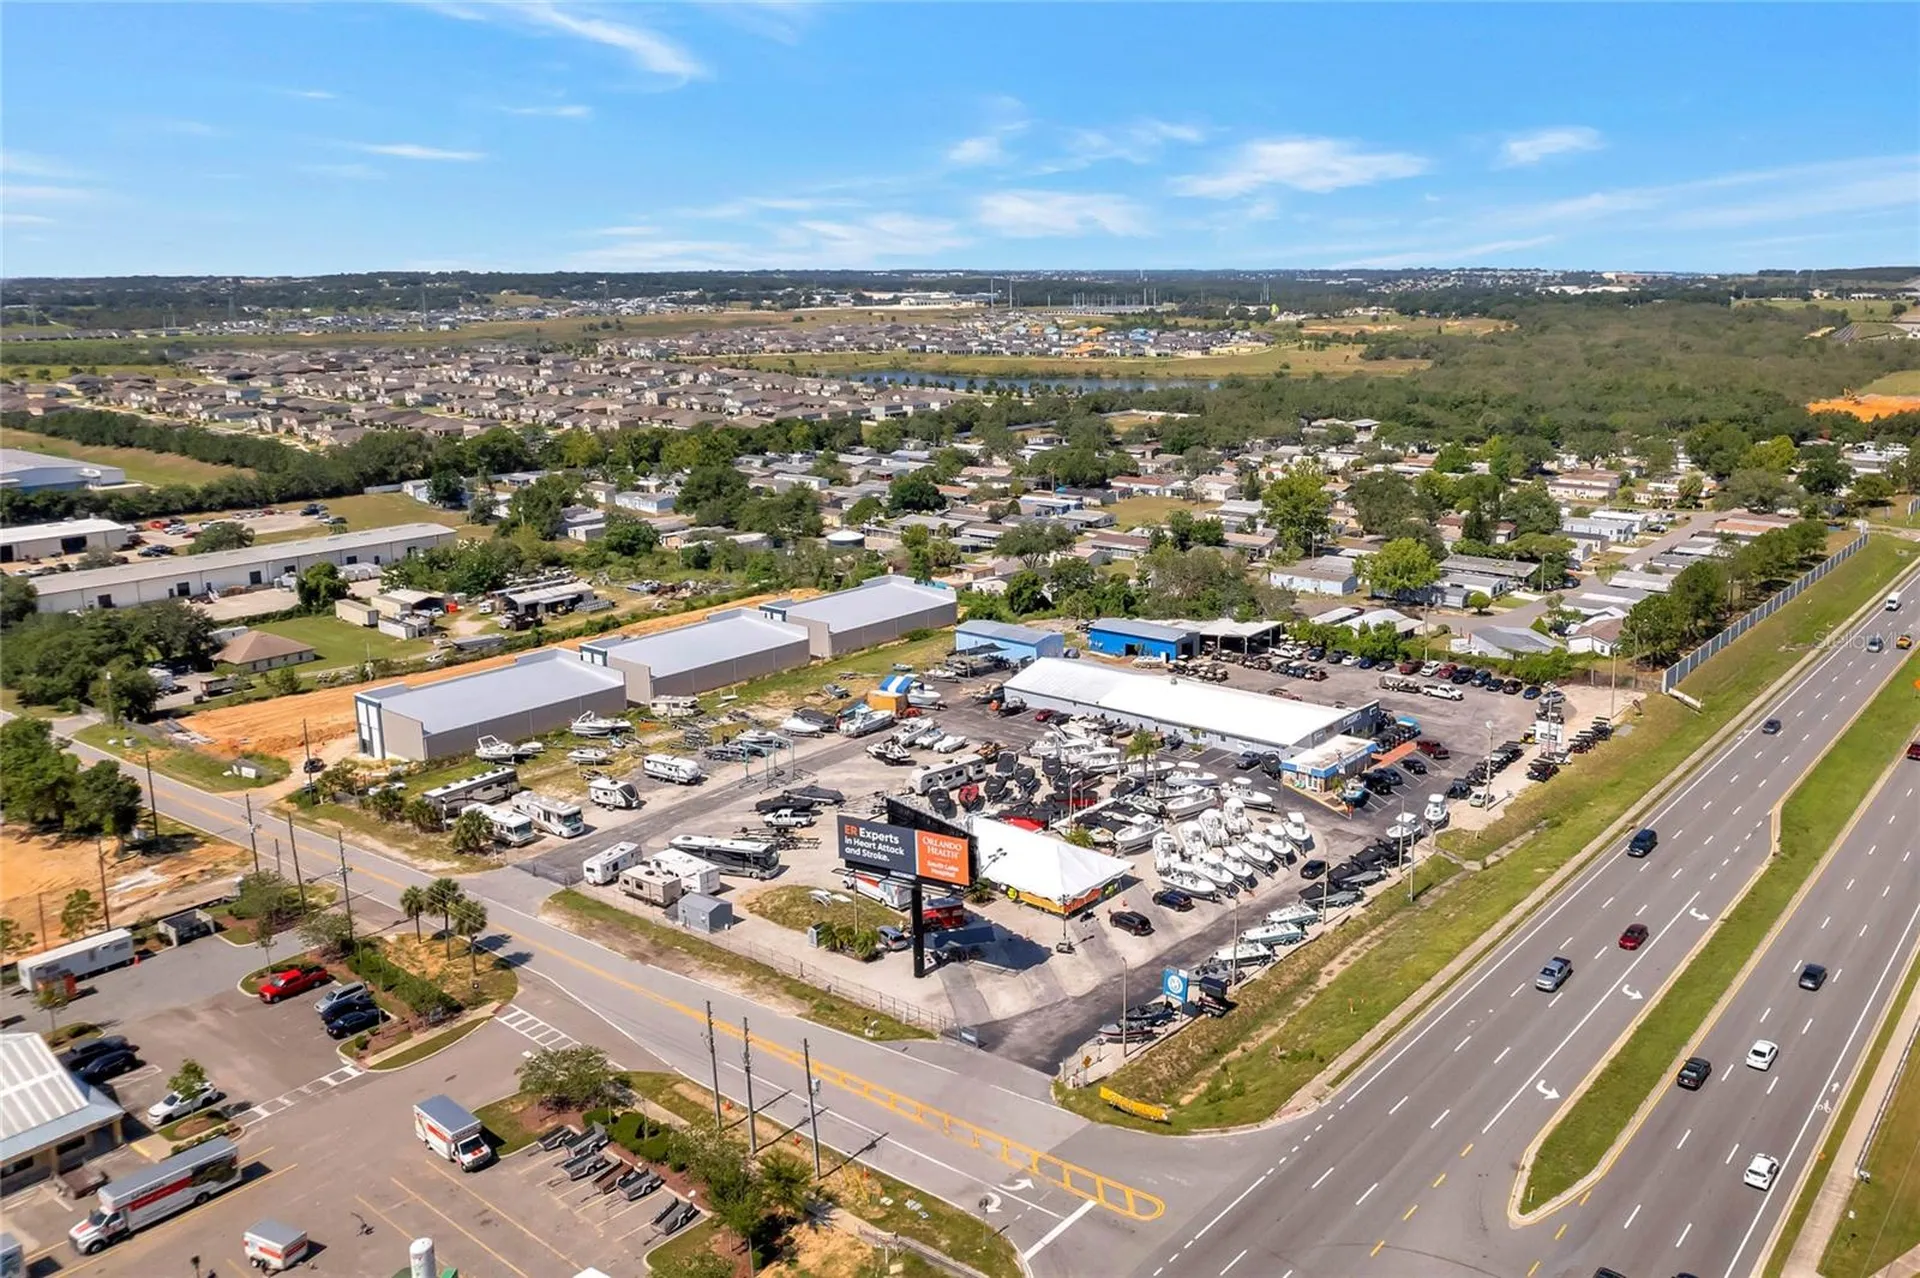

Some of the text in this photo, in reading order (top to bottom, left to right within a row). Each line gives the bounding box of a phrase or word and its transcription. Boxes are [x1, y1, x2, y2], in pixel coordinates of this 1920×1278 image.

[844, 824, 900, 844] ER Experts
[853, 838, 876, 849] Heart
[877, 843, 905, 856] Attack
[923, 836, 962, 850] ORLANDO
[845, 847, 890, 862] and Stroke.
[927, 847, 960, 858] HEALTH
